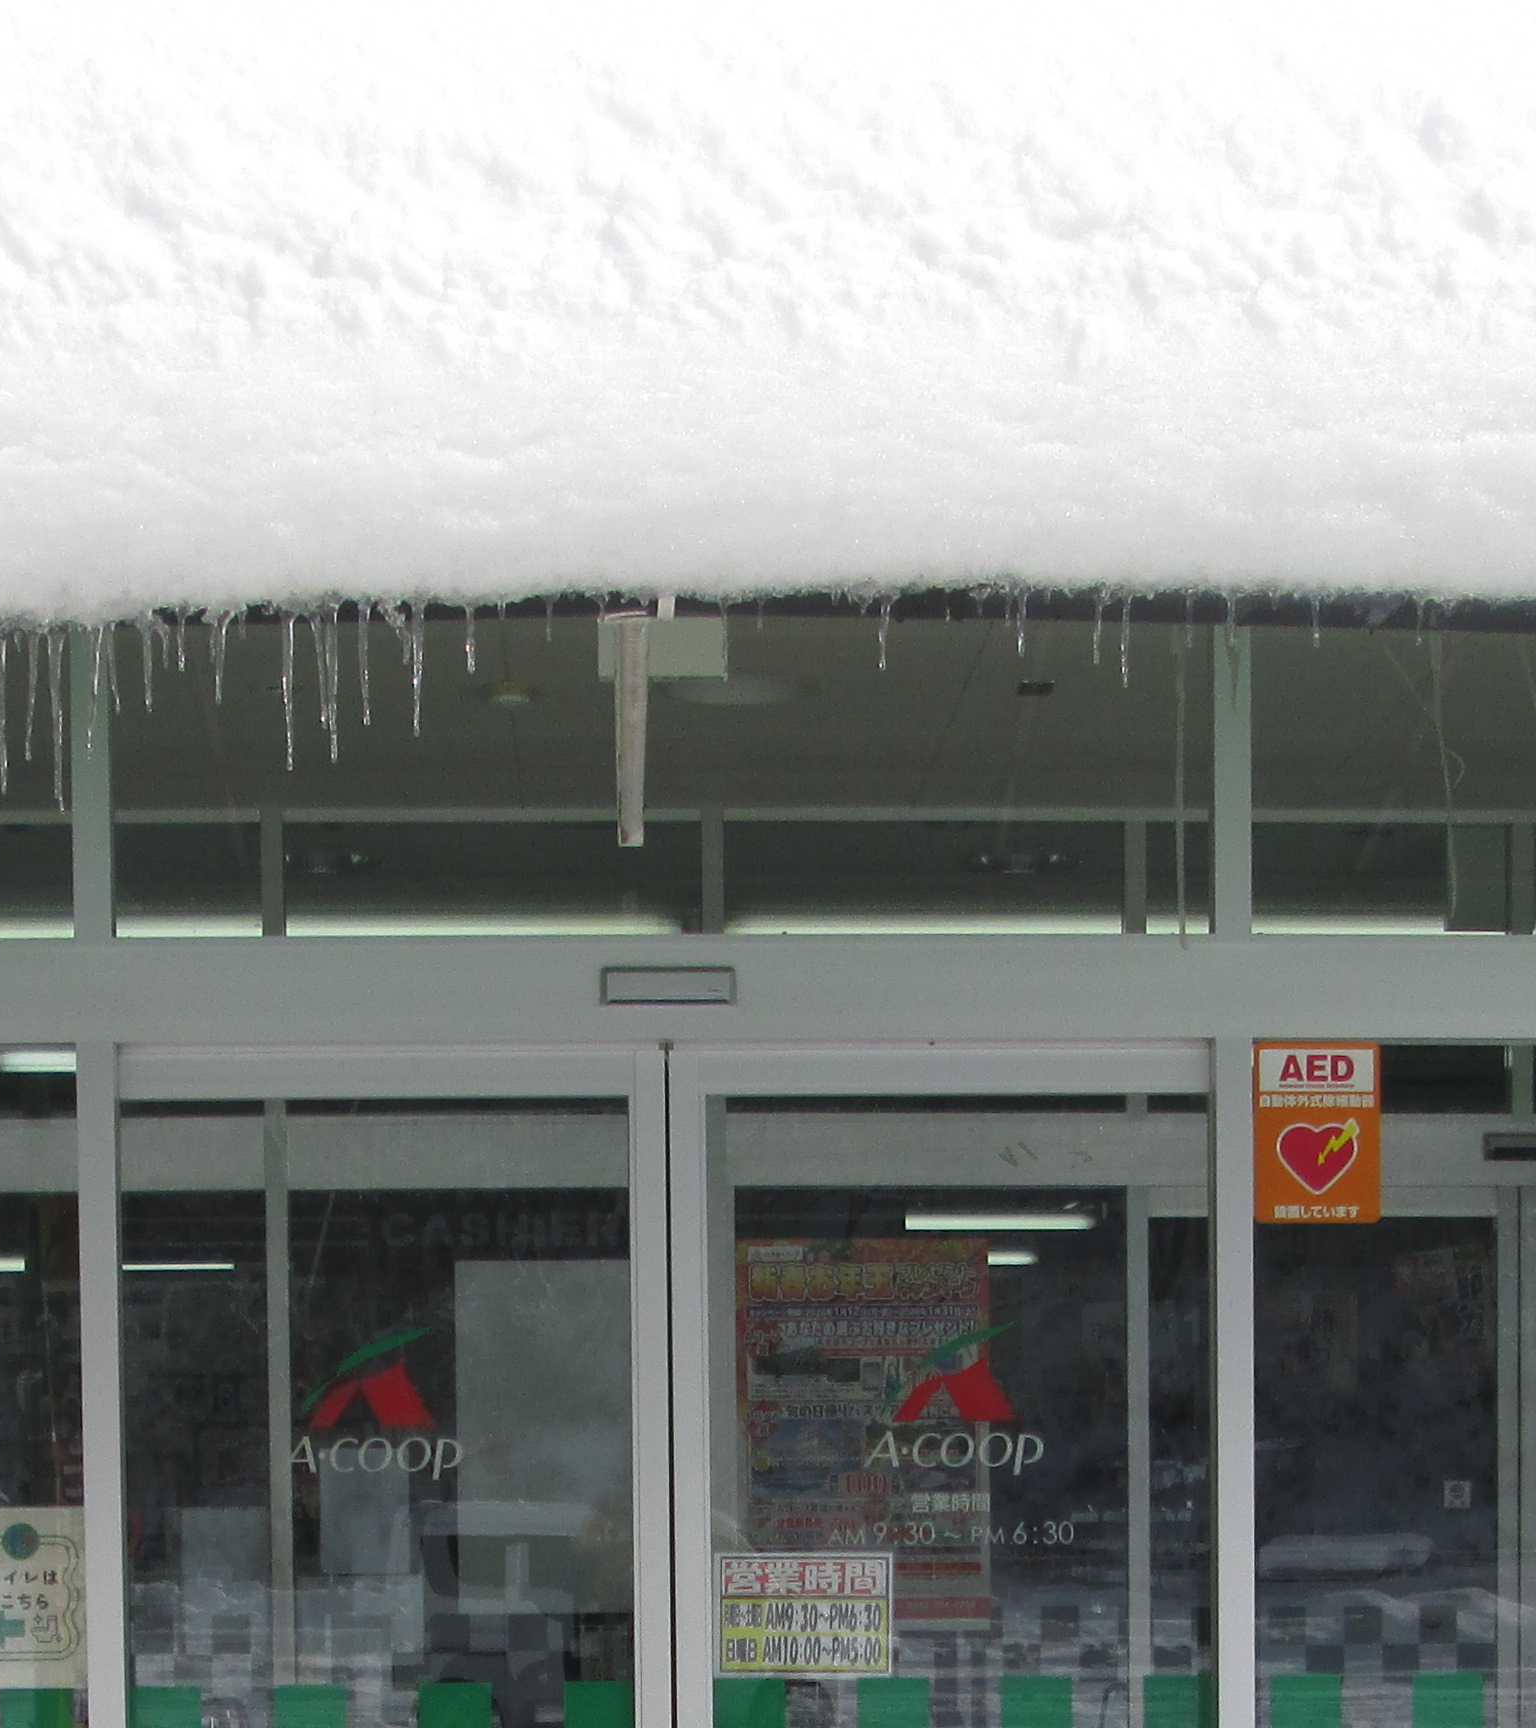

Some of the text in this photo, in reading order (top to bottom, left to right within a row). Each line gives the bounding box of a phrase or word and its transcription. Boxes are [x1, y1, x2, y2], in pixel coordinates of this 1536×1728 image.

[1279, 1054, 1355, 1082] AED
[1274, 1204, 1360, 1219] 設置しています
[910, 1493, 991, 1513] 営業時間
[827, 1528, 864, 1545] AM
[872, 1521, 936, 1546] 9:30
[971, 1526, 1005, 1544] PM
[1012, 1521, 1075, 1545] 6:30
[725, 1560, 883, 1596] 営業時間
[1, 1593, 49, 1610] こちら
[726, 1638, 757, 1662] 日曜日
